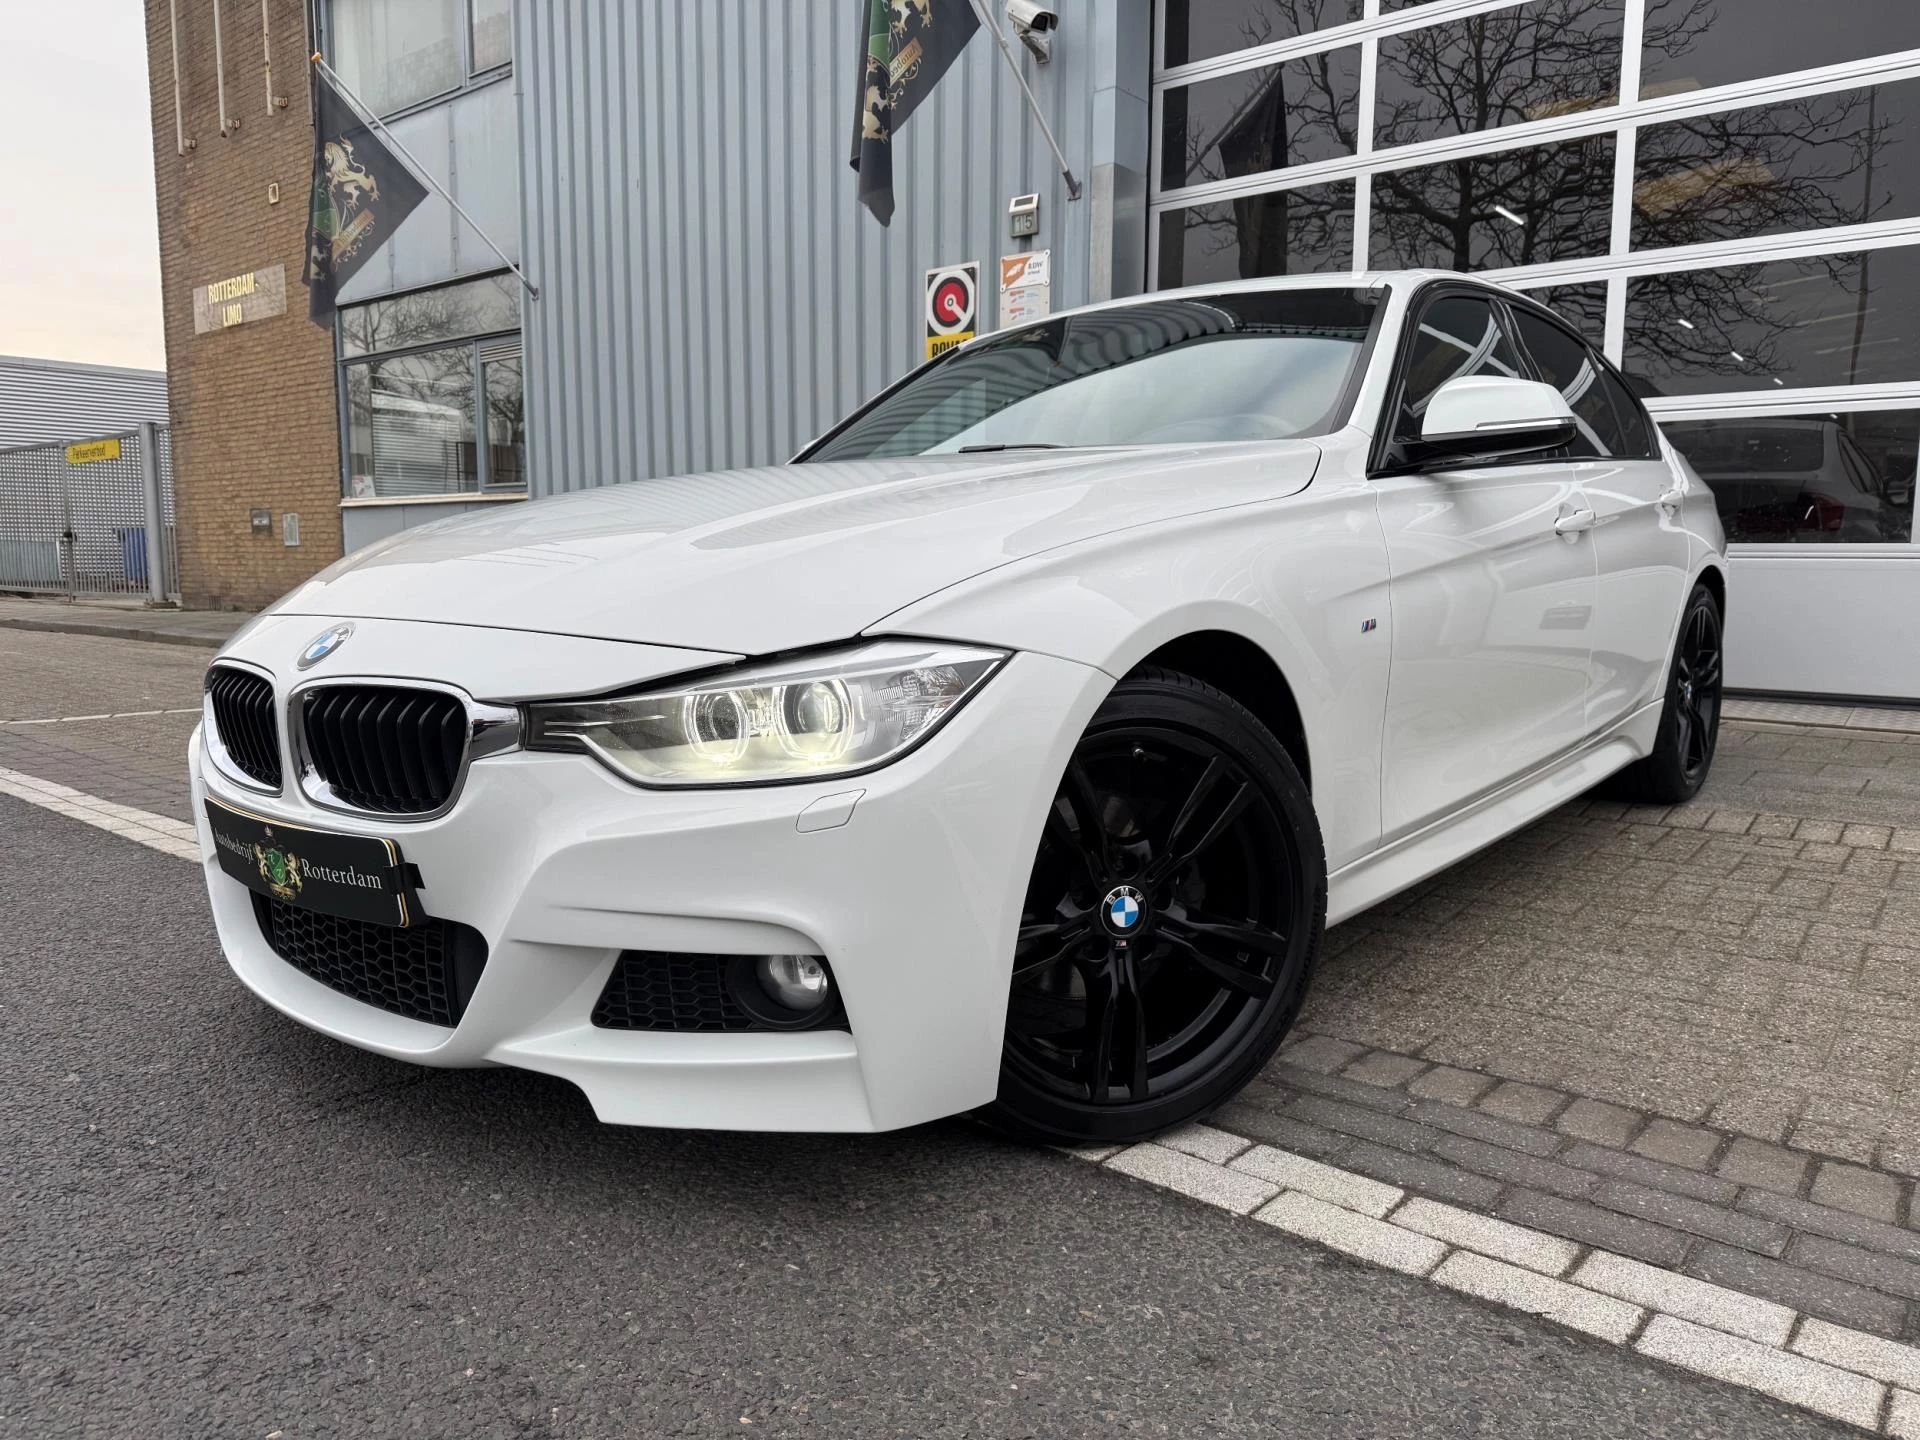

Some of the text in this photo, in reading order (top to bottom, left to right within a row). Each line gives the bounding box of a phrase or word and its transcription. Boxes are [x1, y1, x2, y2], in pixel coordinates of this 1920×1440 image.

[207, 271, 255, 304] ROTTERDAM
[222, 303, 243, 327] LIMO
[301, 857, 384, 890] Rotterdam
[1106, 887, 1144, 905] BMW
